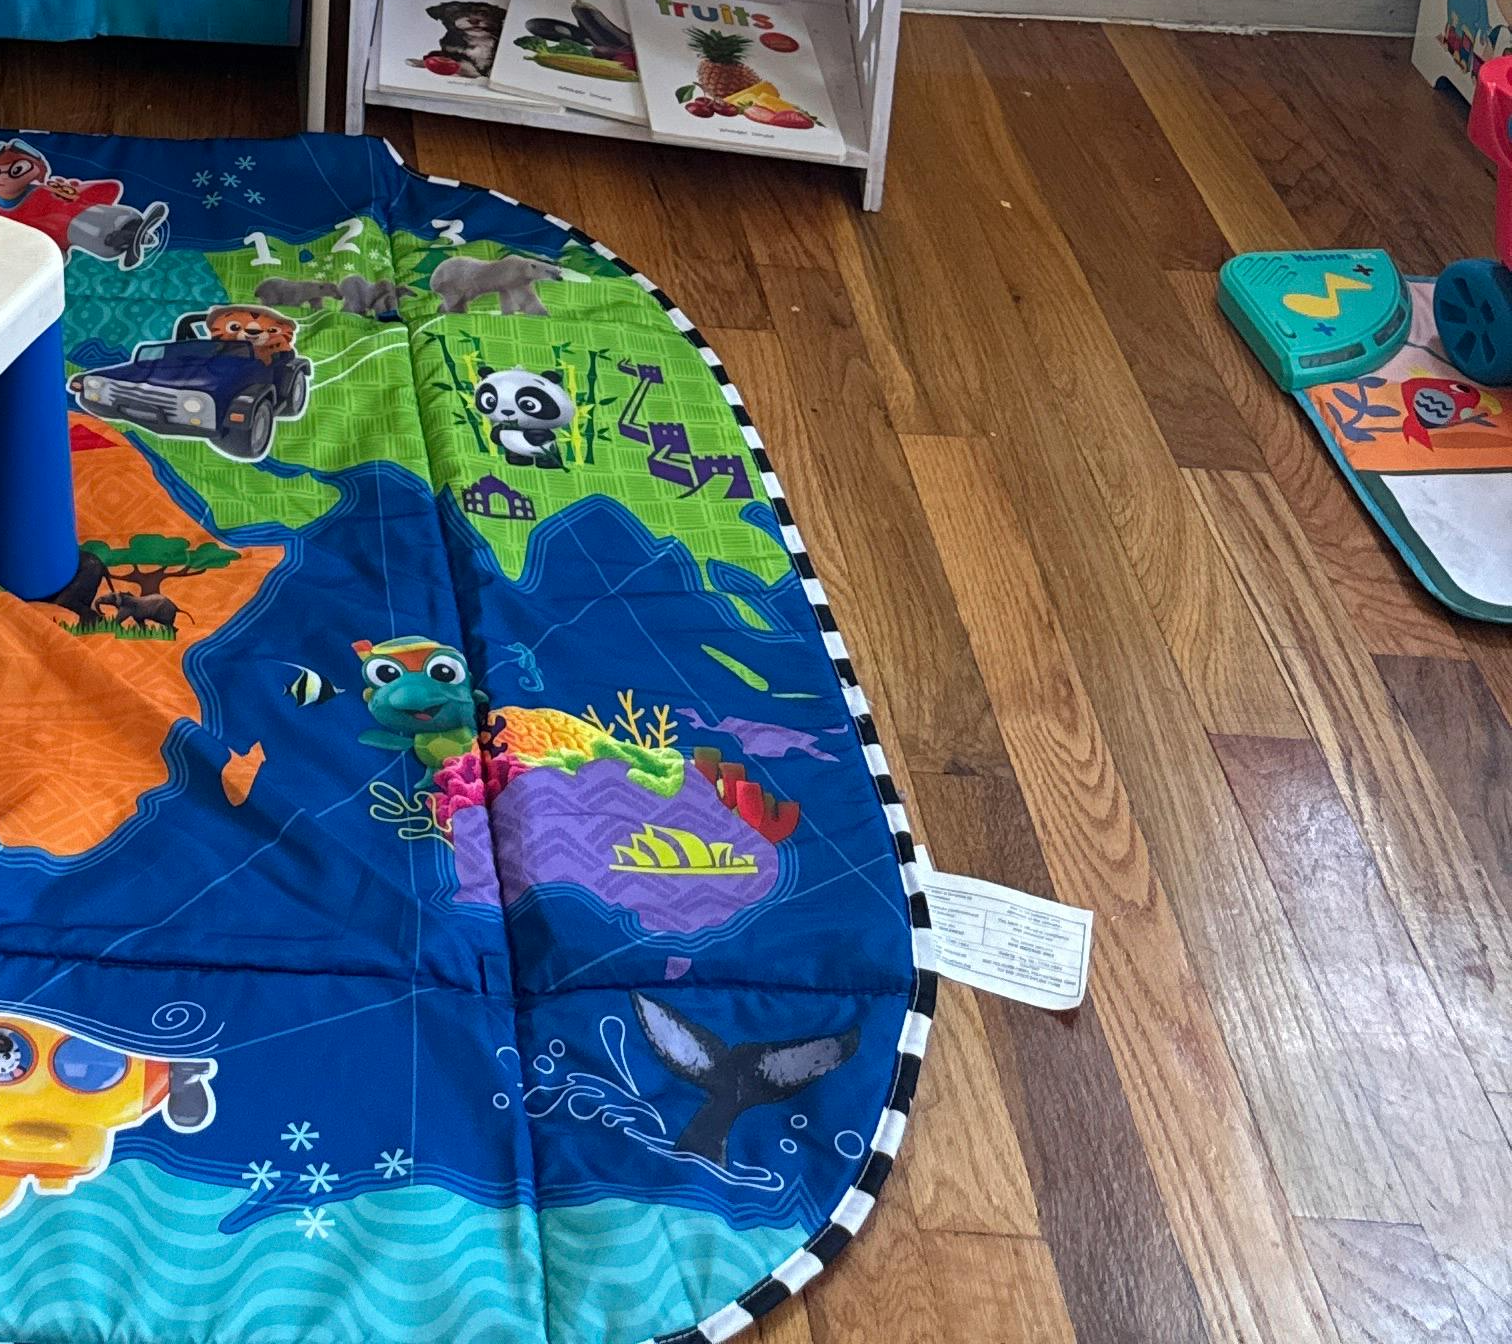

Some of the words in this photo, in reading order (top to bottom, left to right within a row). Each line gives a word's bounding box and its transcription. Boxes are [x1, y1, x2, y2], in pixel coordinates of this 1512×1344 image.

[243, 231, 282, 266] 1
[331, 217, 365, 254] 2
[430, 218, 467, 249] 3
